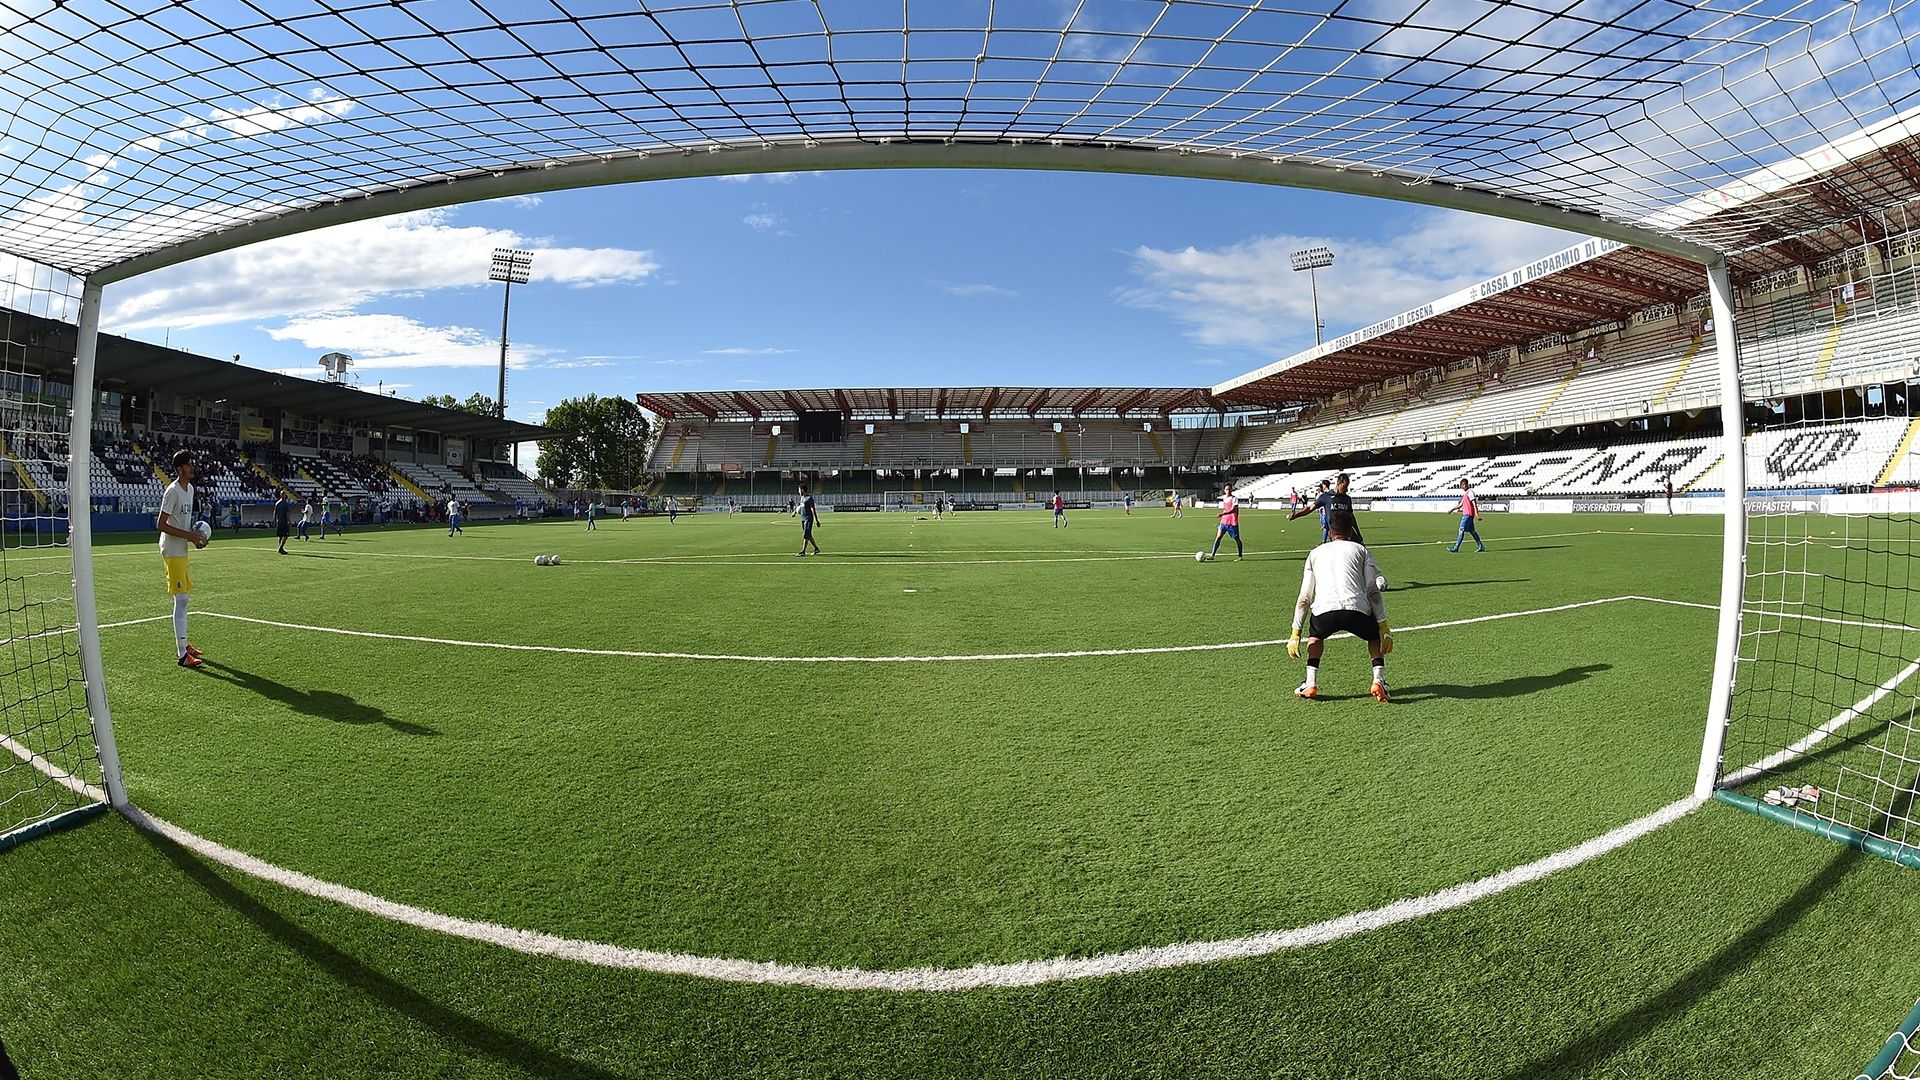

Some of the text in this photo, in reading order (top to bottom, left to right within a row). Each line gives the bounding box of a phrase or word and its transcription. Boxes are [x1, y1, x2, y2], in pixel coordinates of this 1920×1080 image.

[1480, 275, 1509, 297] CASSA
[1513, 270, 1523, 284] DI
[1526, 247, 1581, 280] RISPARMIO
[1585, 241, 1597, 258] DI
[1335, 303, 1434, 350] CASSA DI RISPARMIO DI CESENA
[1573, 503, 1599, 512] FOREVER
[1599, 503, 1621, 512] FASTER
